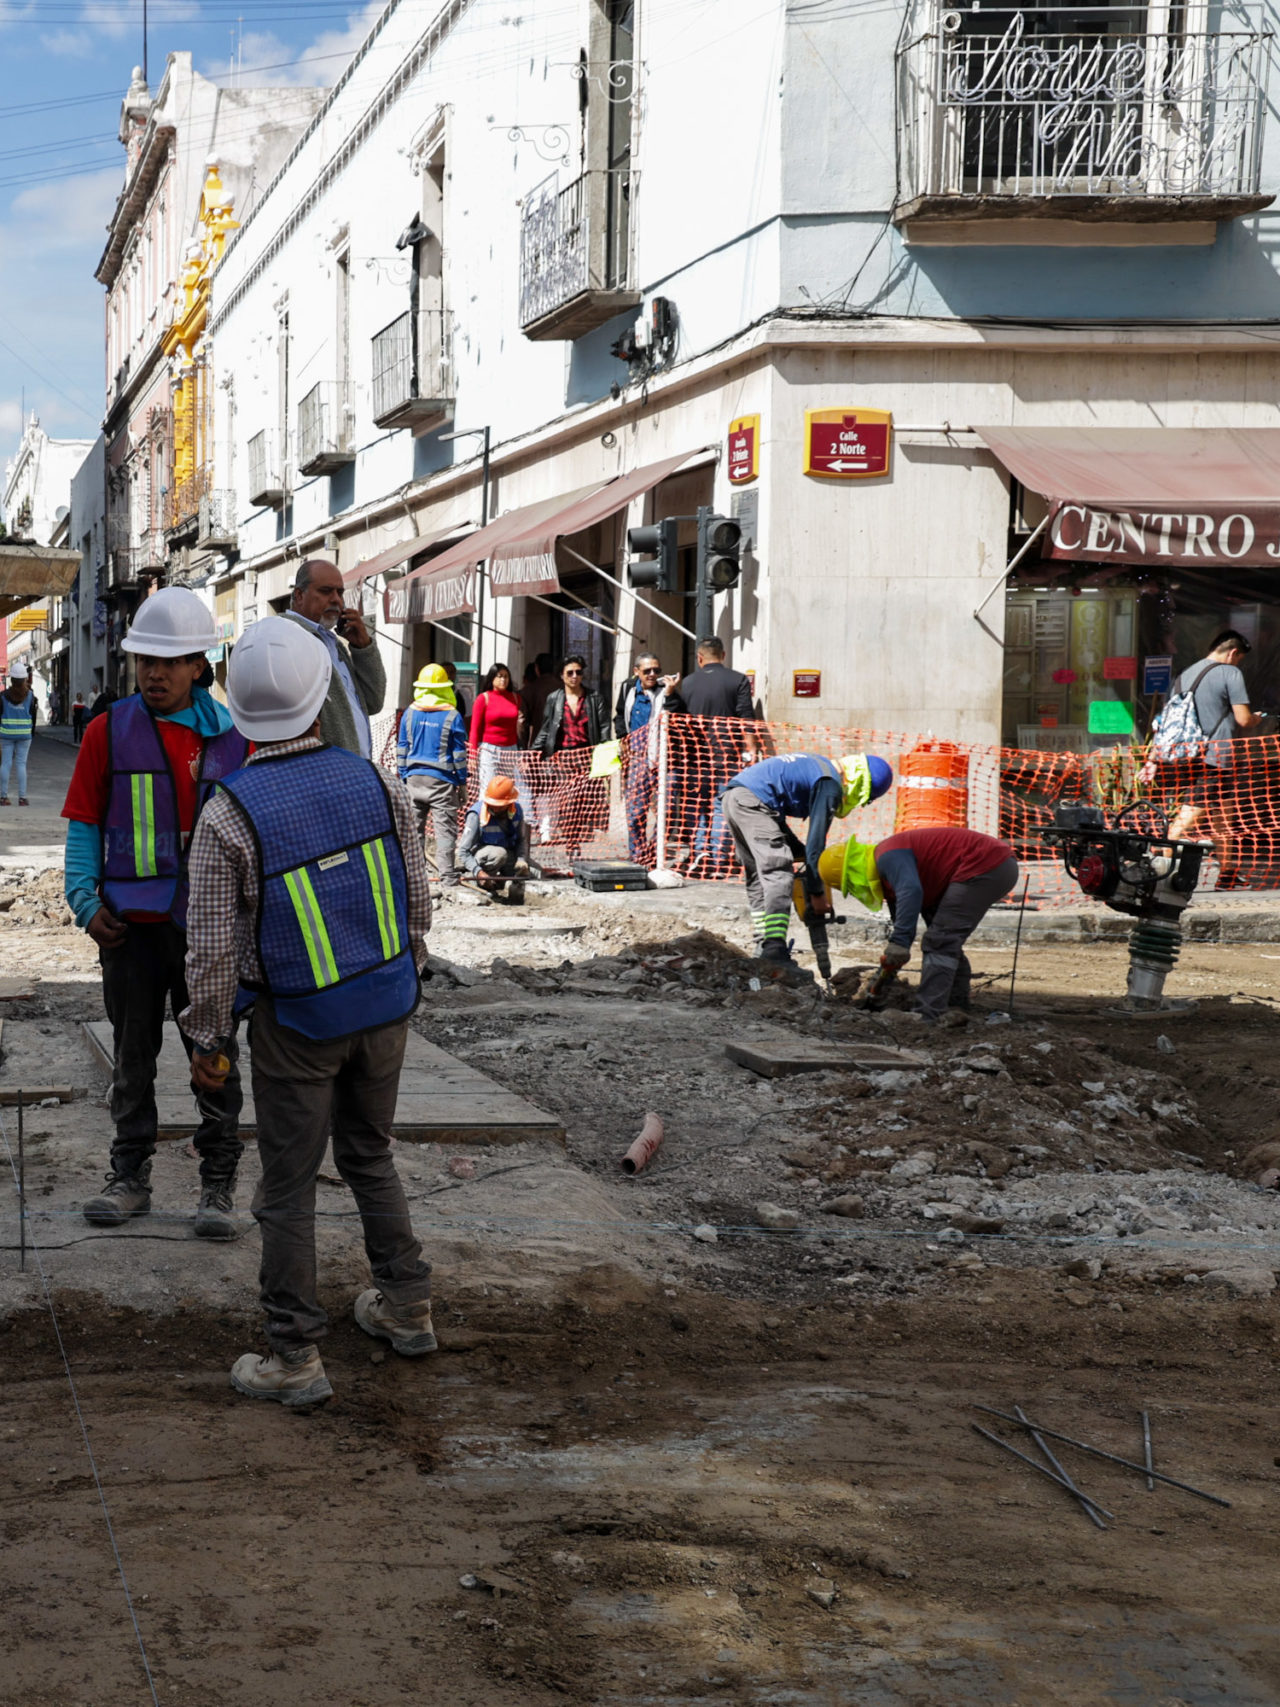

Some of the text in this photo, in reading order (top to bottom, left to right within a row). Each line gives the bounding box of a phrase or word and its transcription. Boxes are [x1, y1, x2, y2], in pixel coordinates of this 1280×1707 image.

[839, 431, 858, 442] Calle
[830, 443, 866, 456] 2 Norte
[1051, 504, 1255, 559] CENTRO
